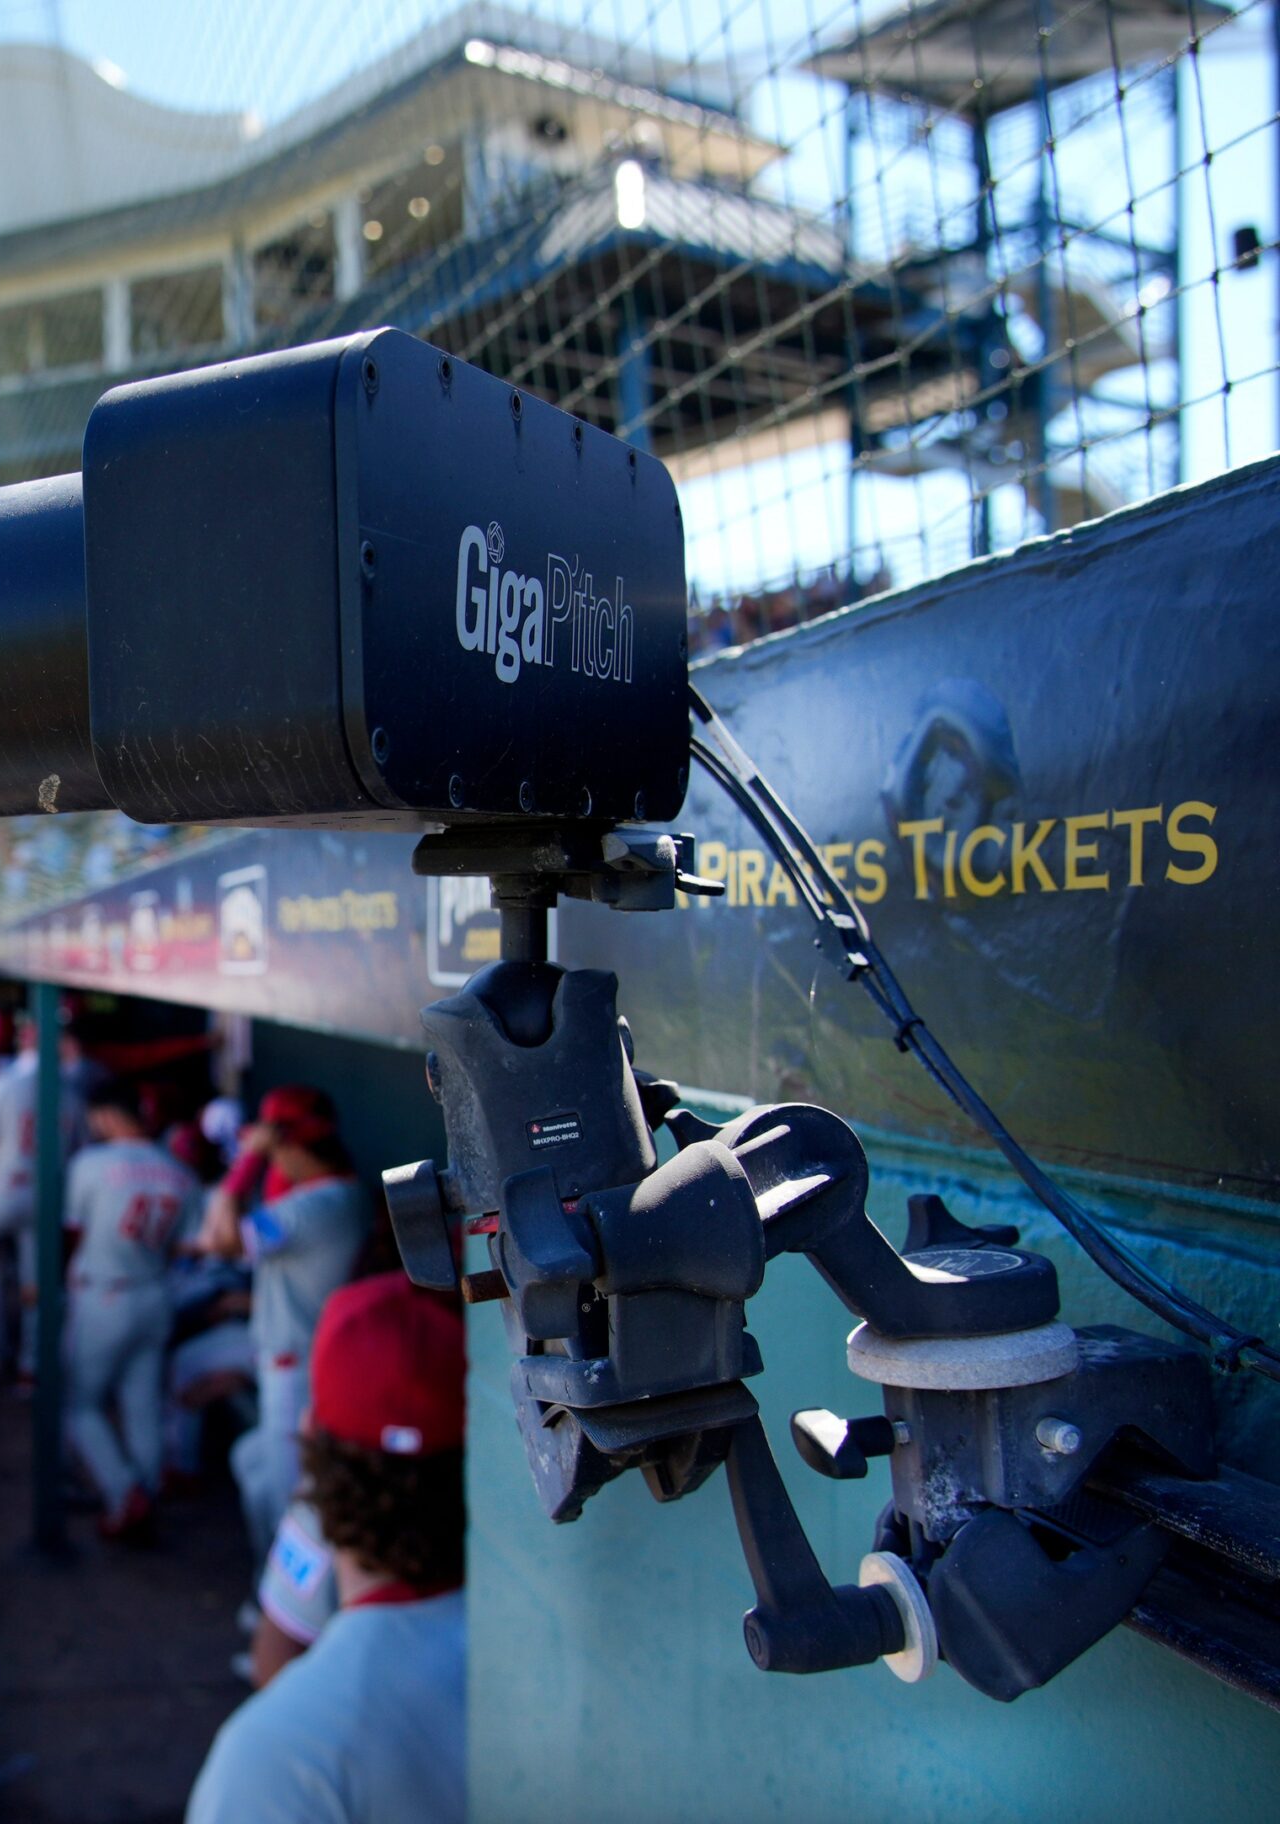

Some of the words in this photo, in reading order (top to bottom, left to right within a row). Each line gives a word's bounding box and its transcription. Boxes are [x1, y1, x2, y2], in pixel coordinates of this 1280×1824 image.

[456, 521, 634, 684] GigaPitch
[698, 839, 888, 909] PIRAES
[898, 800, 1218, 900] TICKETS
[543, 1121, 577, 1132] Manfrotto
